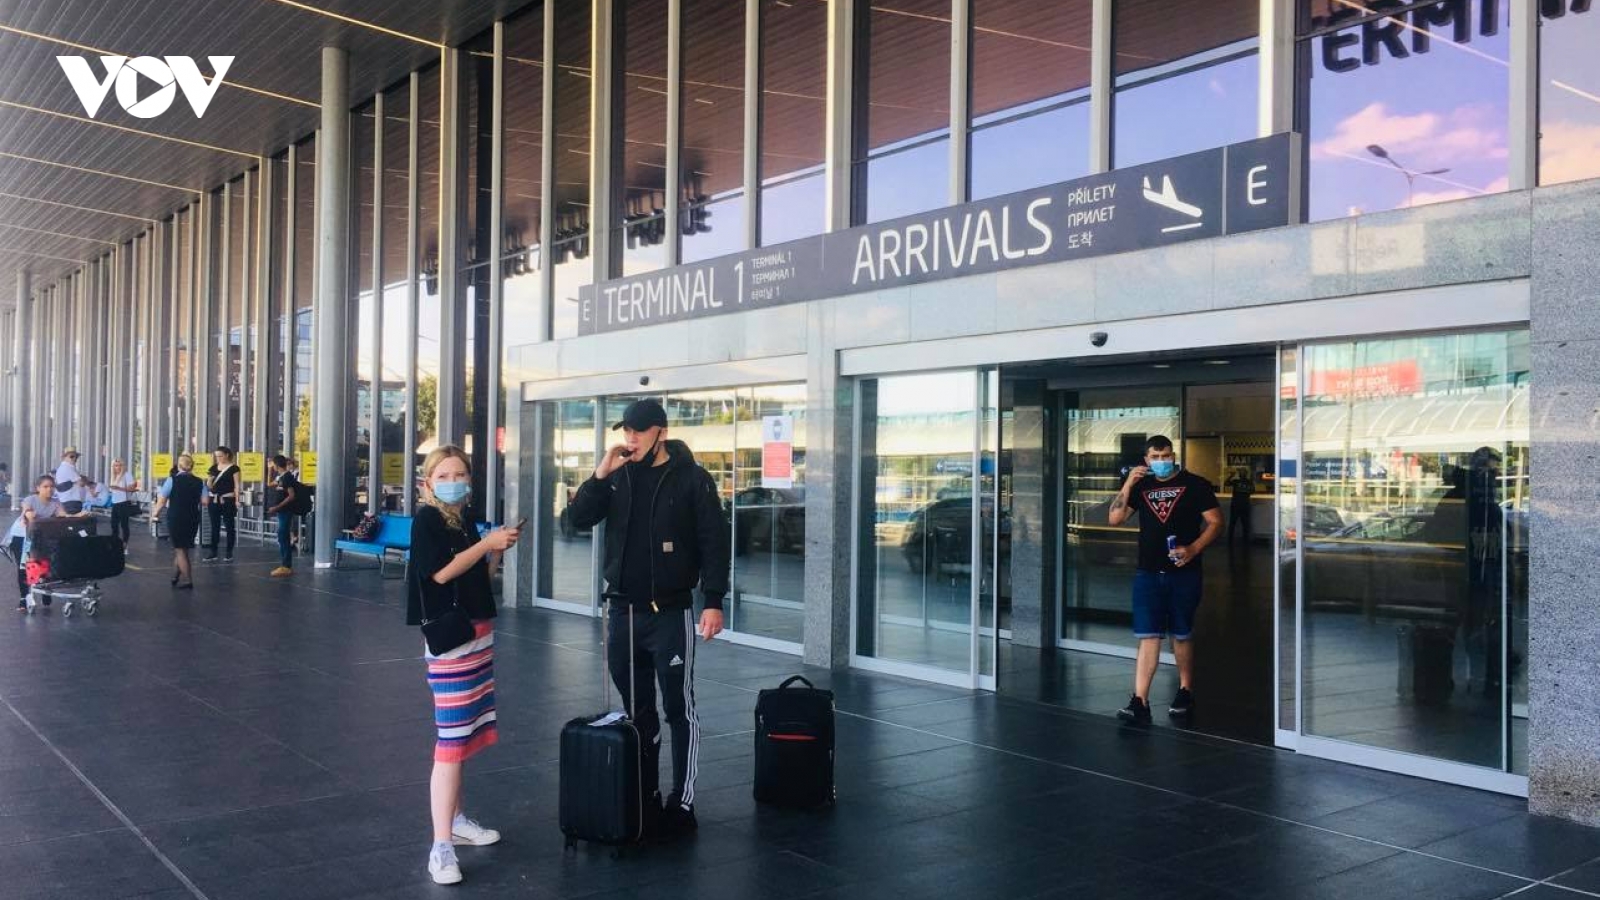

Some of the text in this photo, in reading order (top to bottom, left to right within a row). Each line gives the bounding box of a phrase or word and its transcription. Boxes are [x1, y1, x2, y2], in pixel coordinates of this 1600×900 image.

[1067, 183, 1117, 207] PŘÍLETY
[1247, 165, 1267, 205] E
[1067, 205, 1116, 228] ПРИЛЕТ
[851, 198, 1052, 285] ARRIVALS
[1067, 230, 1094, 249] 도착
[603, 260, 744, 325] TERMINAL 1
[582, 299, 591, 321] E
[1148, 490, 1177, 499] GUESS
